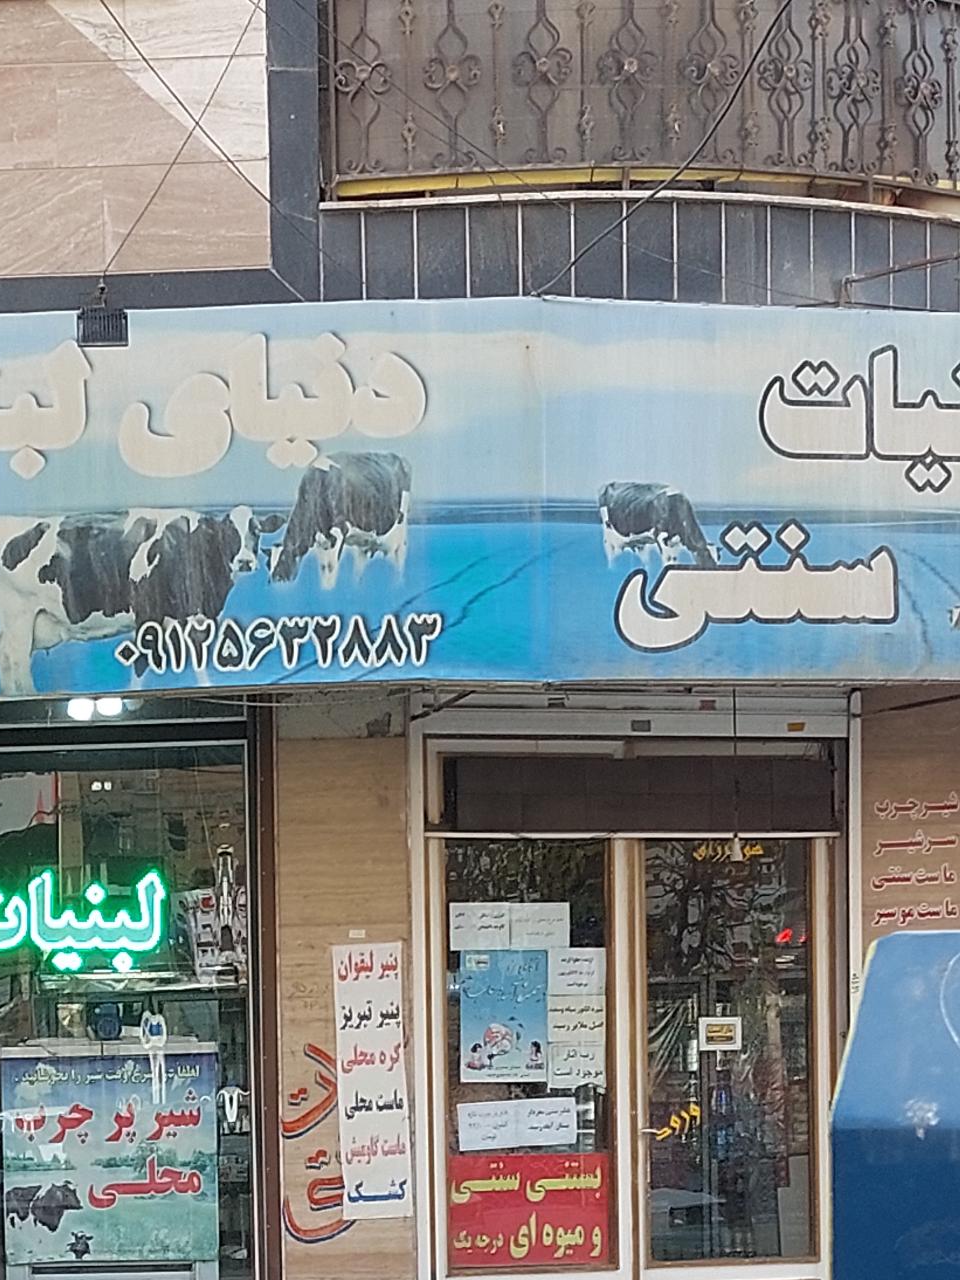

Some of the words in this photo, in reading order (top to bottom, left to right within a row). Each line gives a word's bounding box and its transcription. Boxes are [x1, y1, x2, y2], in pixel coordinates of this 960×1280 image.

[117, 331, 427, 479] دنیای
[613, 518, 900, 654] سنتی
[919, 791, 959, 820] شیر
[337, 949, 374, 982] لیقوان
[378, 952, 399, 981] پنیر
[339, 1000, 373, 1031] تبریز
[376, 1001, 401, 1029] پنیر
[341, 1042, 376, 1074] محلی
[378, 1042, 401, 1073] کره
[147, 1088, 202, 1142] شیر
[345, 1089, 373, 1121] محلی
[375, 1088, 404, 1113] ماست
[105, 1101, 137, 1143] پر
[87, 1155, 202, 1209] محلی
[347, 1178, 407, 1204] کشک
[450, 1161, 521, 1204] سنتی
[526, 1161, 603, 1203] بستنی
[509, 1210, 538, 1259] ای
[541, 1222, 586, 1258] میوه
[590, 1225, 602, 1257] و
